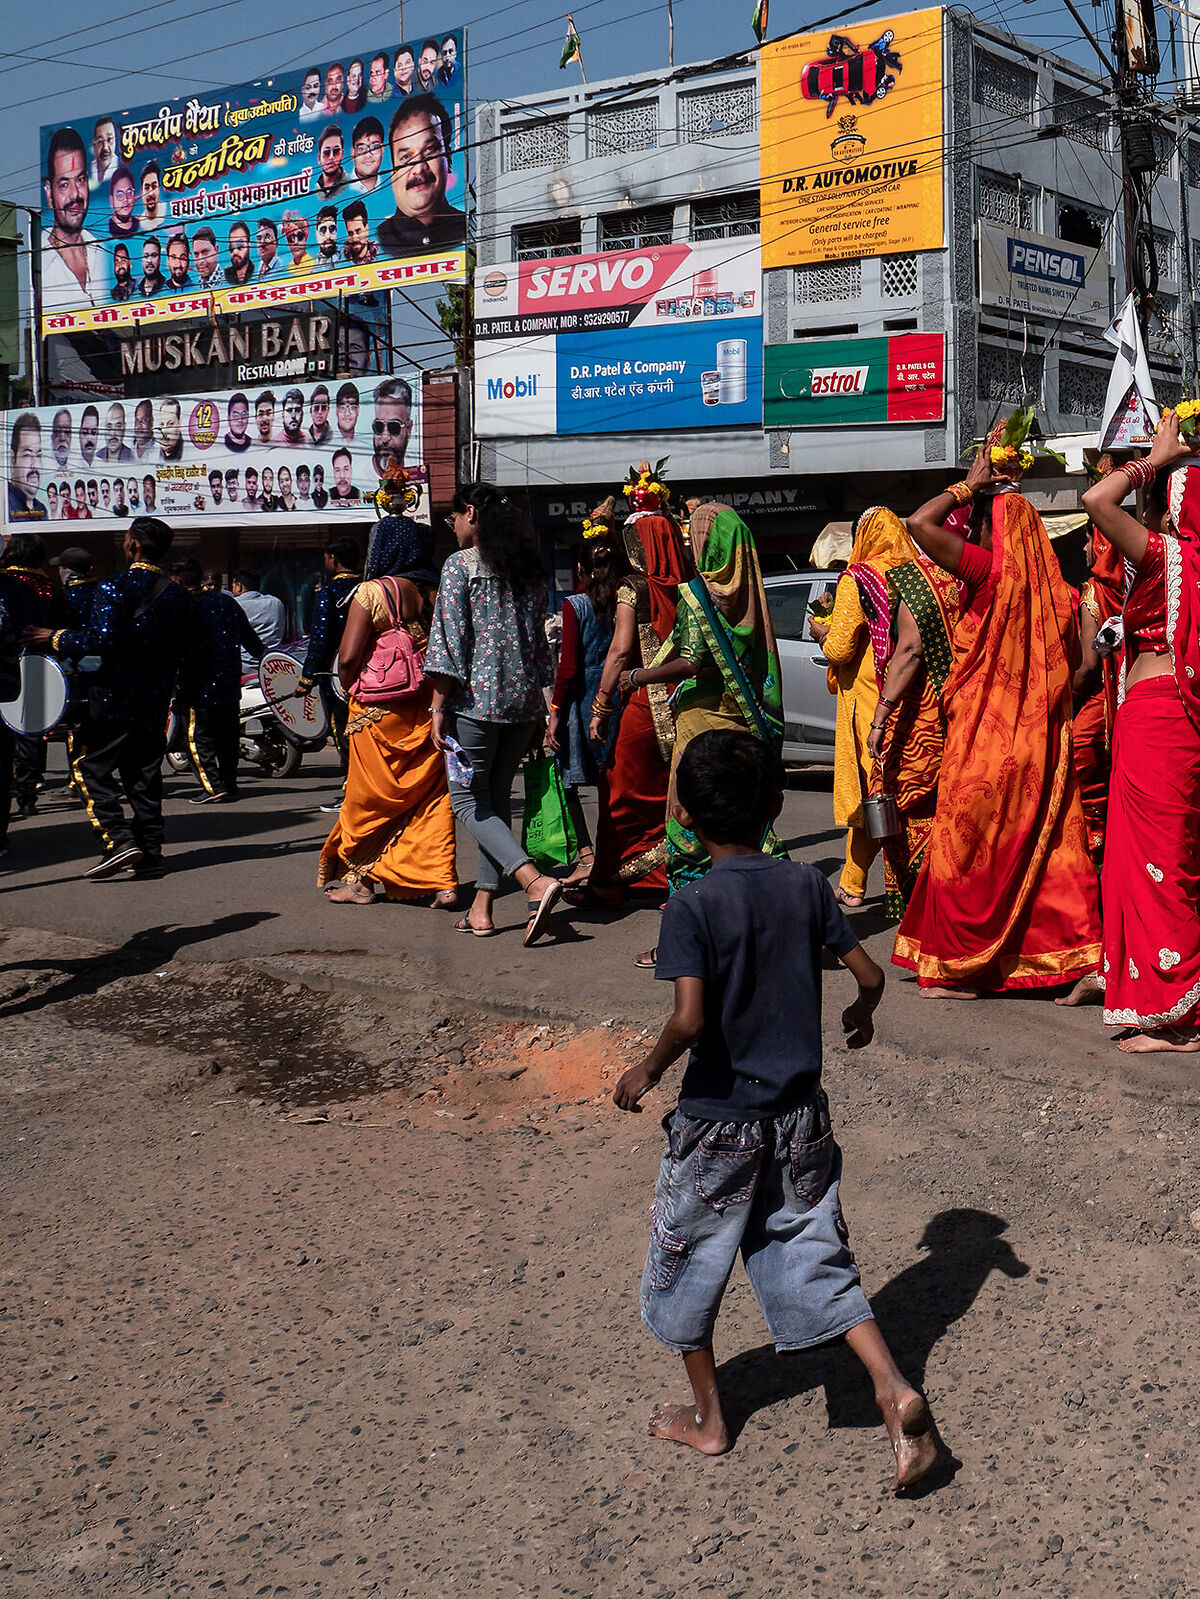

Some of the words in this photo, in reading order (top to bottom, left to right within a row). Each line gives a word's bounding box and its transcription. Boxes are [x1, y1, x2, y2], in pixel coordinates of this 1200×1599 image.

[162, 134, 270, 188] जन्मदिन
[274, 138, 286, 157] की
[782, 176, 808, 193] D.R.
[812, 160, 918, 189] AUTOMOTIVE
[809, 222, 840, 234] General
[843, 219, 870, 230] service
[873, 216, 890, 229] free
[377, 259, 460, 280] सागर
[1011, 245, 1082, 283] PENSOL
[526, 256, 655, 300] SERVO
[475, 323, 490, 336] D.R.
[491, 321, 512, 334] PATEL
[514, 320, 520, 332] &
[121, 325, 250, 376] MUSKAN
[262, 316, 332, 358] BAR
[570, 365, 592, 379] D.R.
[594, 362, 620, 377] Patel
[623, 362, 632, 374] &
[634, 360, 687, 375] Company
[487, 373, 537, 400] Mobil
[604, 381, 626, 396] पटेल
[629, 380, 643, 396] एंड
[647, 377, 674, 394] कंपनी
[196, 405, 212, 428] 12
